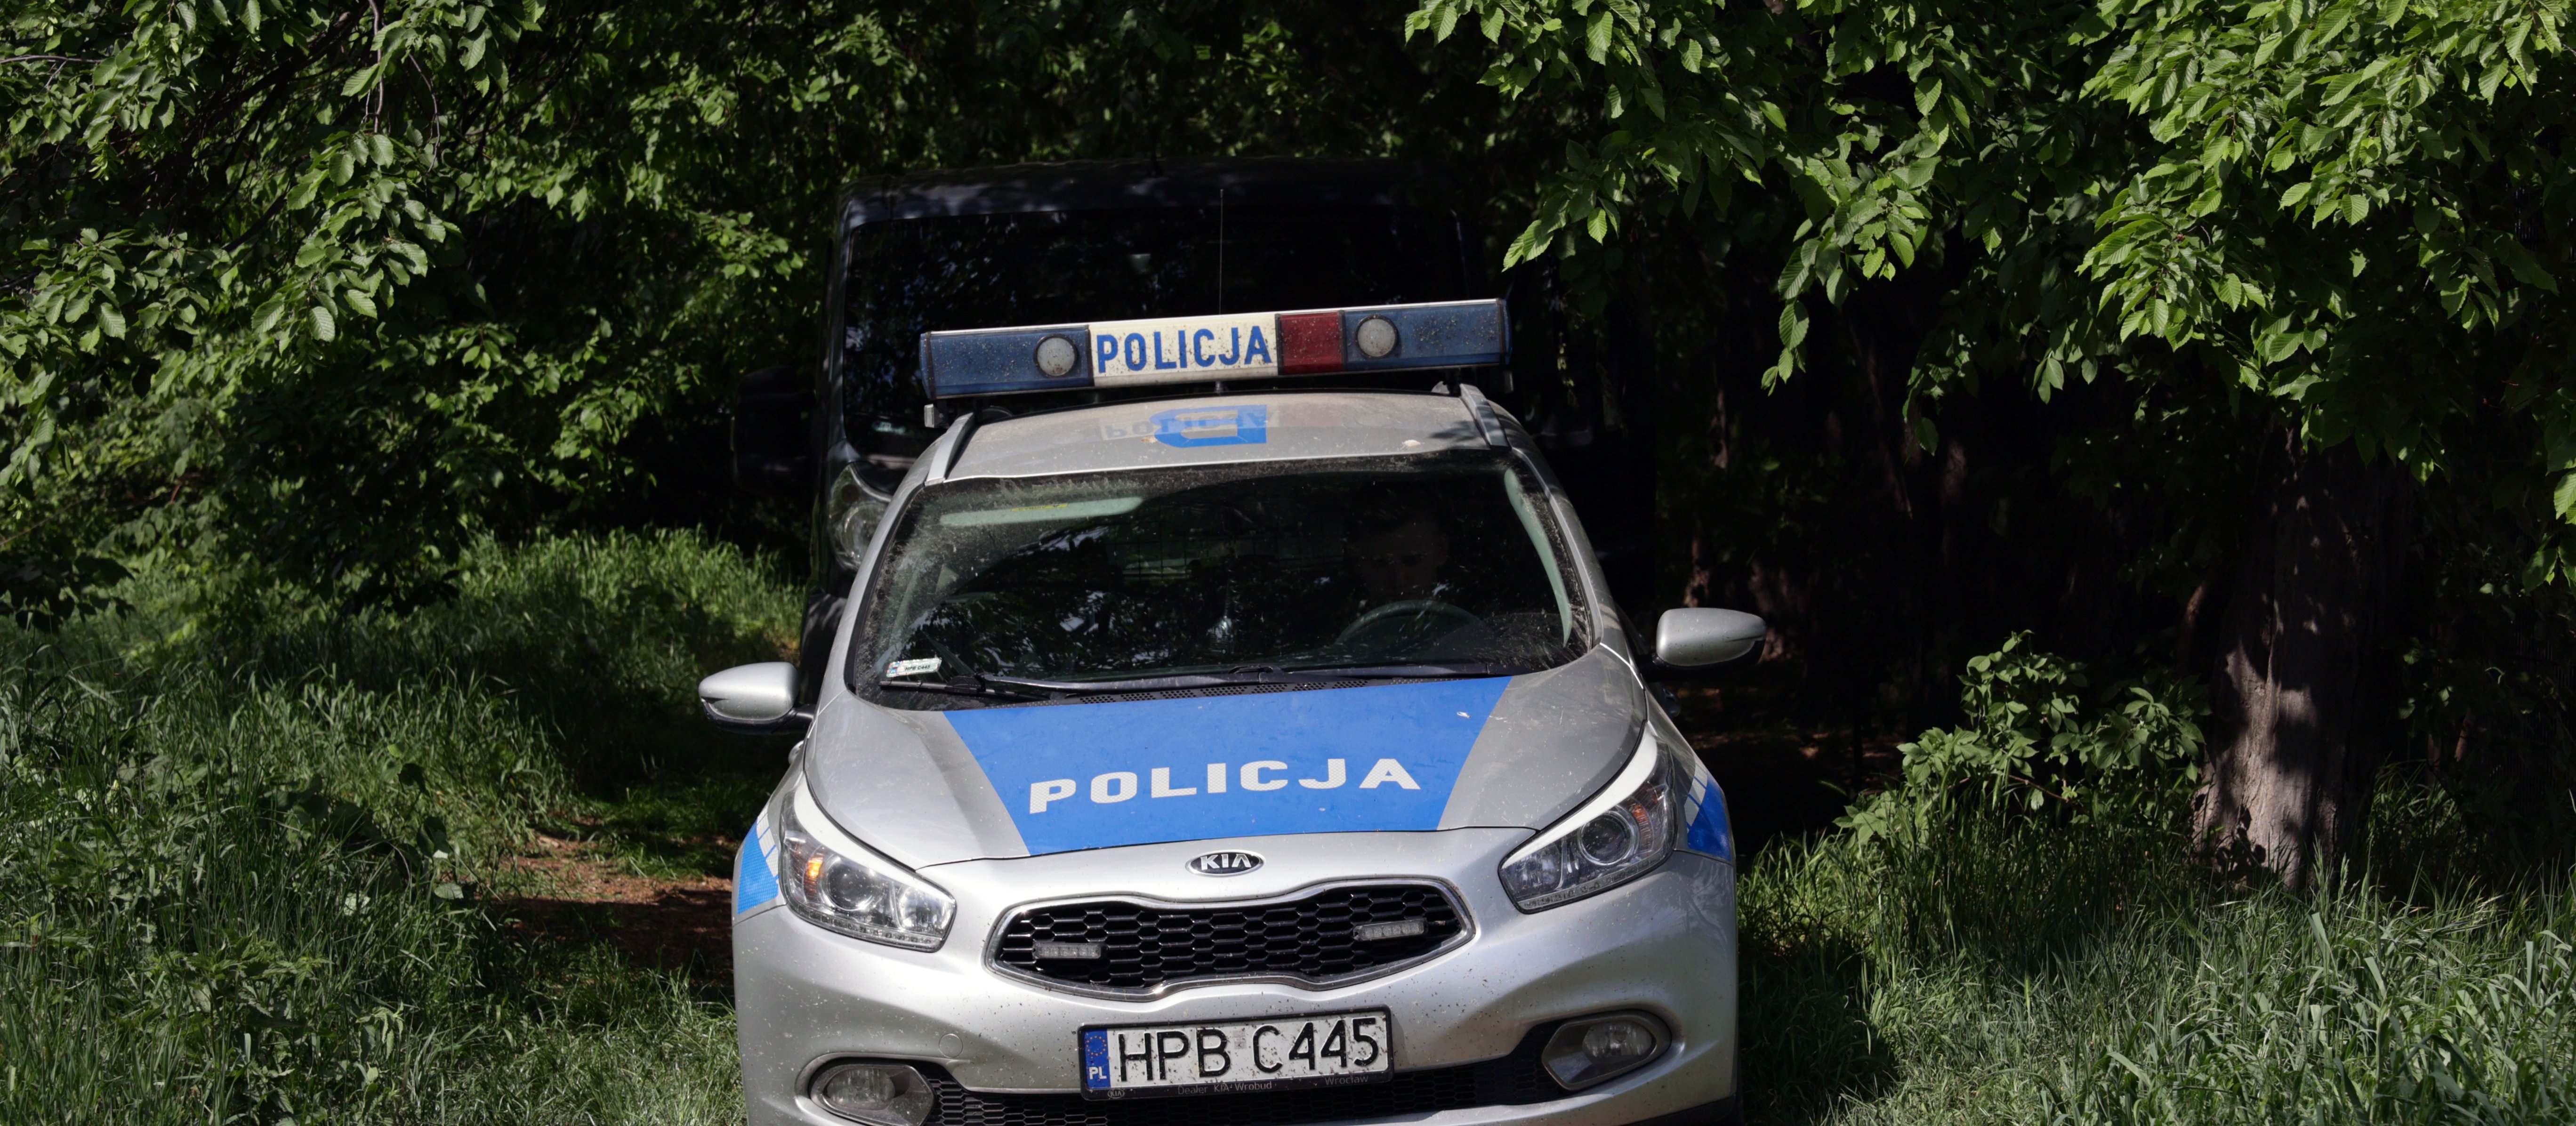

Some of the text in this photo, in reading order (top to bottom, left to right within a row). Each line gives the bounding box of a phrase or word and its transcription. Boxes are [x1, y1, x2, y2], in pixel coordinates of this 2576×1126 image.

[1097, 326, 1271, 373] POLICJA
[1030, 758, 1421, 814] POLICJA
[1200, 853, 1252, 870] KIA
[1118, 1017, 1377, 1082] HPB C445
[1089, 1066, 1107, 1080] PL
[1178, 1085, 1208, 1094] Dealer
[1235, 1082, 1272, 1091] Wrobud
